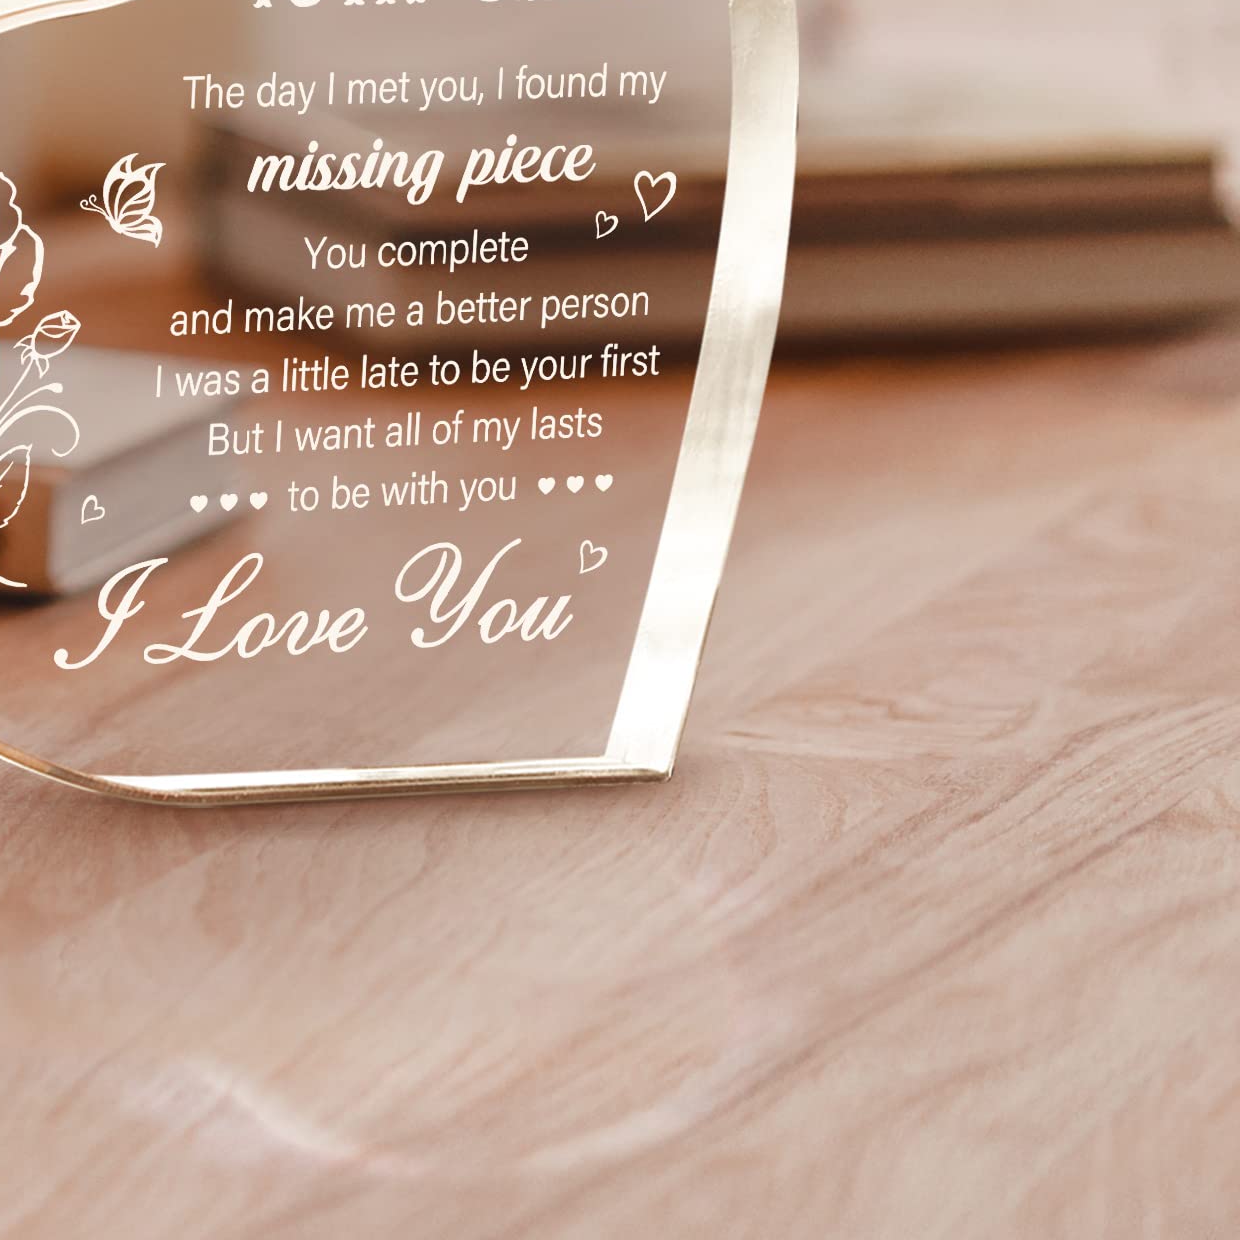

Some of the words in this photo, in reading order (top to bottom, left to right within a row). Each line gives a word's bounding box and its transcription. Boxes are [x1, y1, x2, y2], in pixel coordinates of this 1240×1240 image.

[182, 72, 246, 110] The
[255, 70, 317, 116] day
[327, 70, 336, 106] I
[346, 70, 411, 106] met
[418, 75, 485, 112] you,
[497, 66, 505, 101] I
[514, 61, 609, 100] found
[618, 70, 668, 105] my
[246, 137, 446, 206] missing
[455, 133, 597, 204] piece
[303, 235, 367, 270] You
[377, 228, 530, 274] complete
[169, 298, 234, 337] and
[244, 295, 335, 333] make
[345, 301, 396, 329] me
[405, 300, 424, 327] a
[435, 291, 533, 326] better
[540, 291, 650, 330] person
[155, 364, 163, 399] I
[174, 369, 241, 398] was
[250, 368, 270, 395] a
[282, 355, 350, 393] little
[360, 353, 419, 390] late
[428, 354, 461, 386] to
[471, 349, 511, 385] be
[519, 353, 594, 391] your
[600, 342, 661, 378] first
[207, 422, 265, 457] But
[275, 419, 283, 453] I
[294, 417, 377, 452] want
[384, 411, 421, 449] all
[431, 408, 465, 446] of
[472, 416, 522, 451] my
[530, 405, 603, 441] lasts
[286, 480, 320, 513] to
[330, 474, 371, 511] be
[380, 469, 449, 507] with
[458, 476, 517, 513] you
[52, 556, 170, 671] I
[142, 551, 370, 666] Love
[393, 537, 574, 650] You
